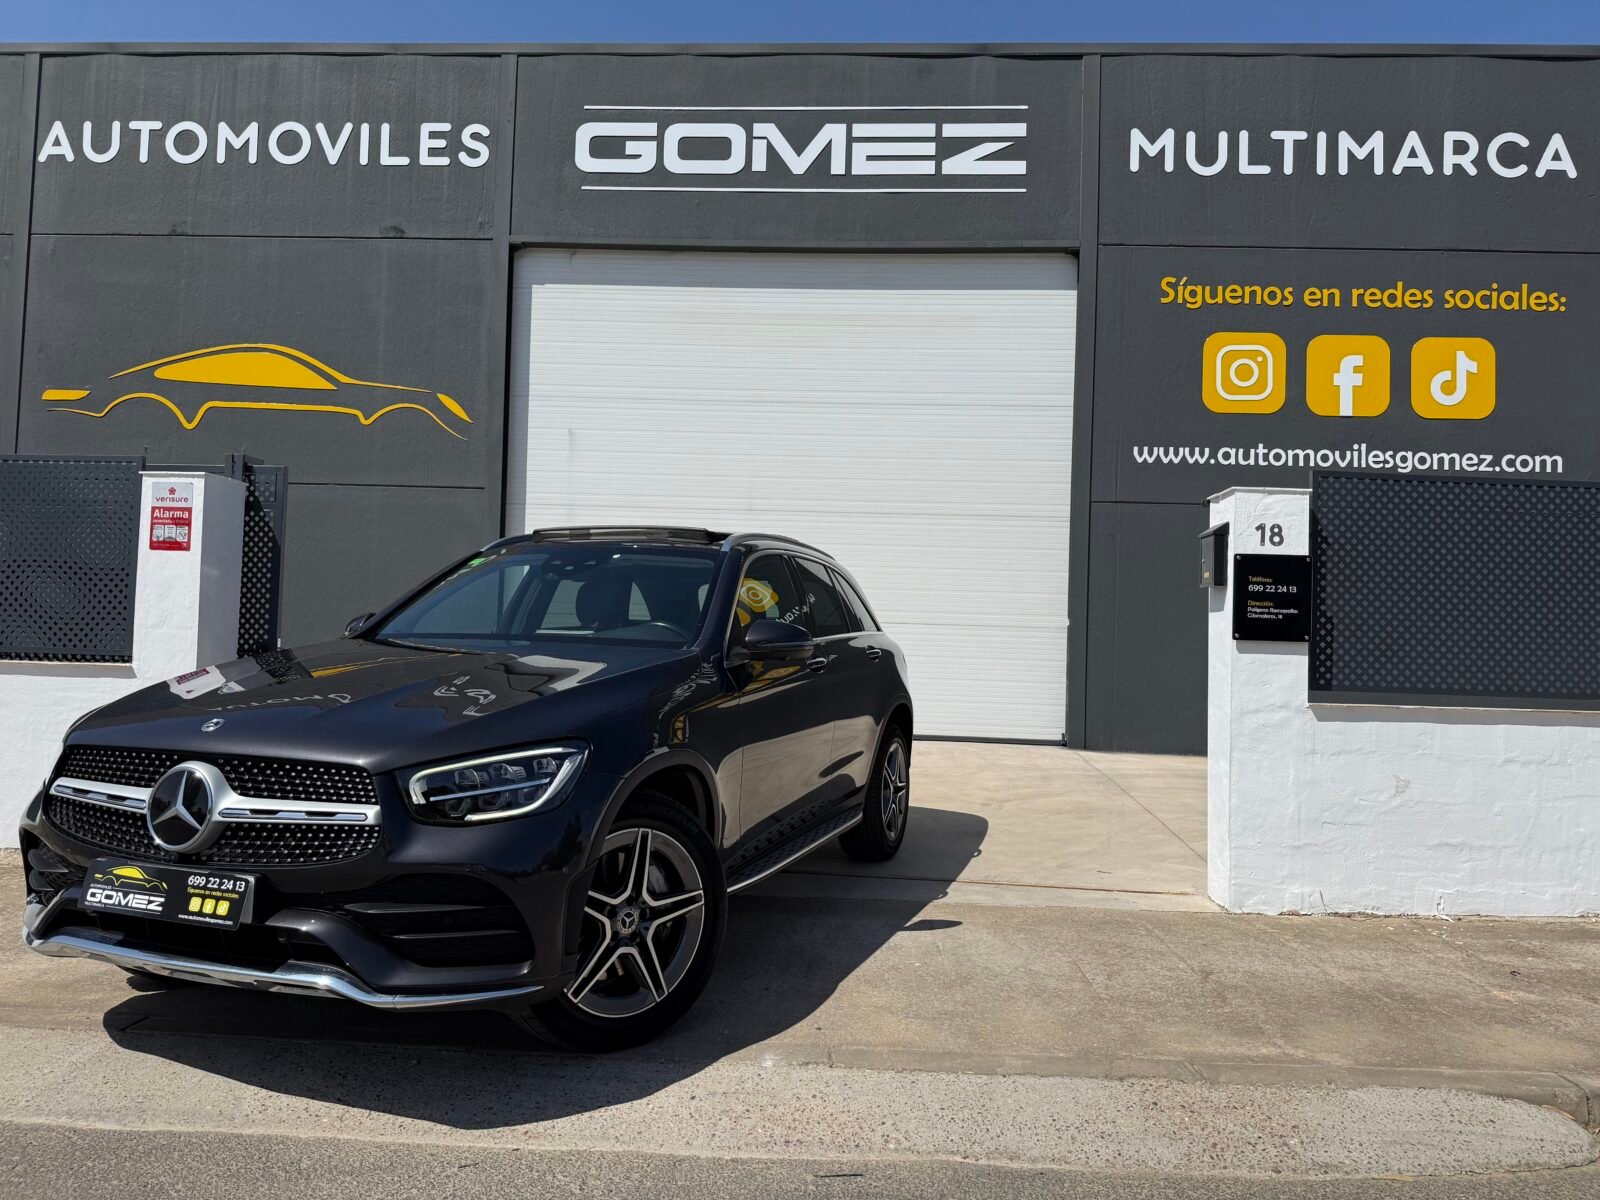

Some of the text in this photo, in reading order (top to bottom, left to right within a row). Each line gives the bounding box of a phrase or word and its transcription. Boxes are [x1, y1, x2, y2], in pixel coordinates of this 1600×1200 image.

[38, 120, 491, 168] AUTOMOVILES
[574, 121, 1027, 175] GOMEZ
[1129, 127, 1578, 179] MULTIMARCA
[1160, 276, 1567, 312] Síguenos en redes sociales:
[1133, 443, 1563, 473] www.automovilesgomez.com
[153, 508, 189, 519] Alarma
[1254, 523, 1285, 547] 18
[187, 875, 246, 892] 699 22 24 13
[86, 888, 165, 911] GOMEZ
